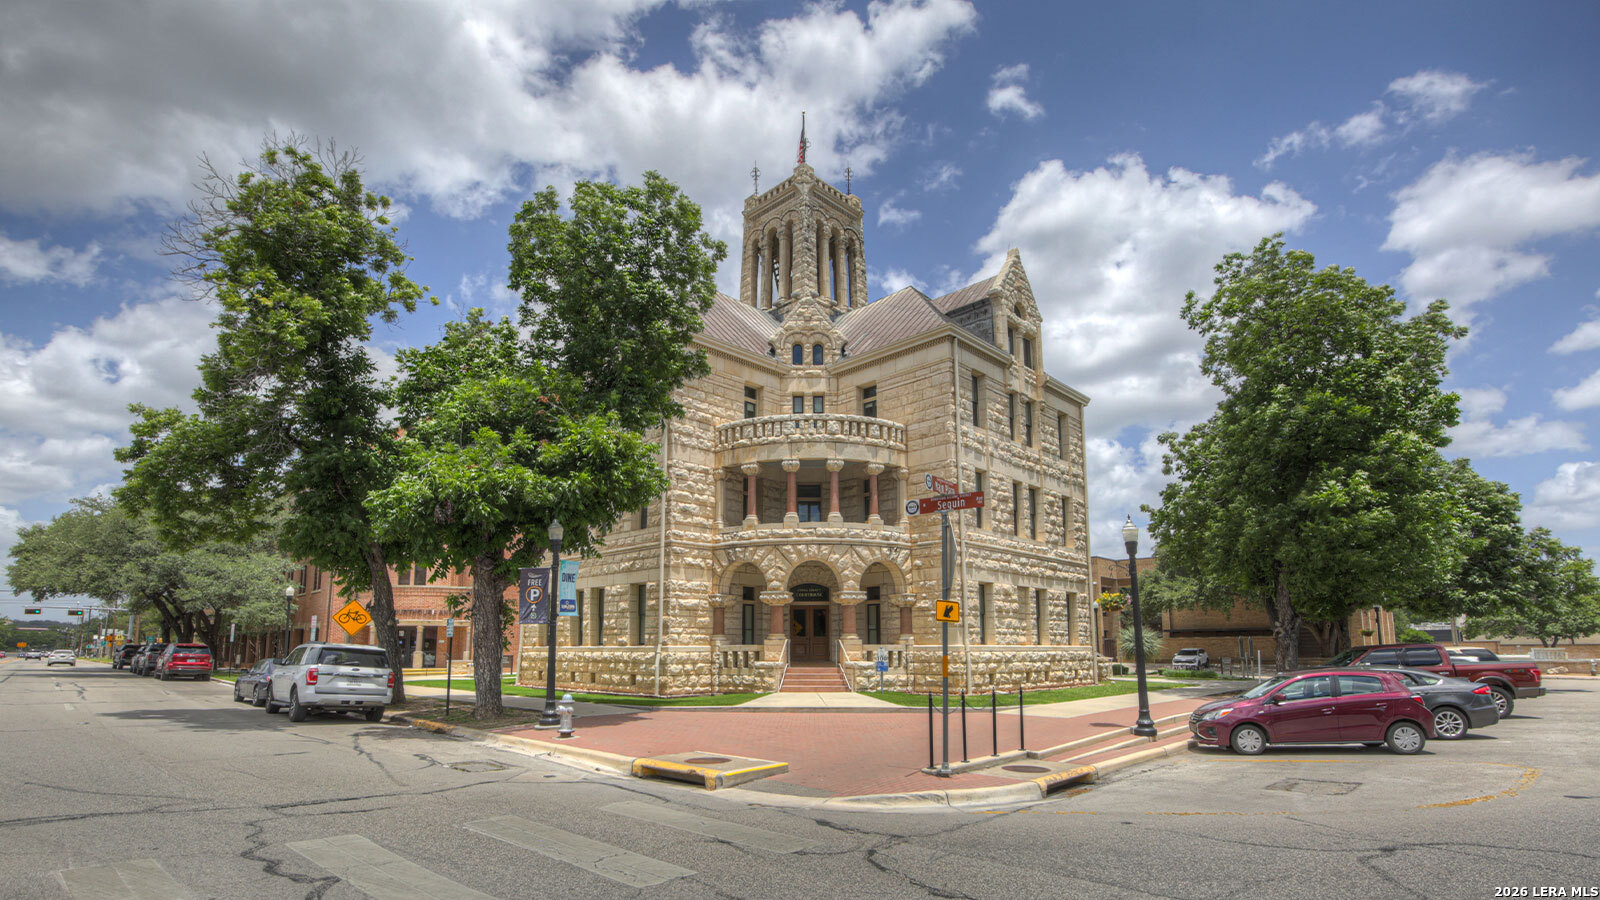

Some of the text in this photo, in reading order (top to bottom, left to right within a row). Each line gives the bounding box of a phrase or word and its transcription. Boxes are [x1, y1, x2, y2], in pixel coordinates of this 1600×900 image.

[937, 498, 965, 511] Seguin
[561, 573, 576, 583] DINE
[530, 588, 540, 601] P
